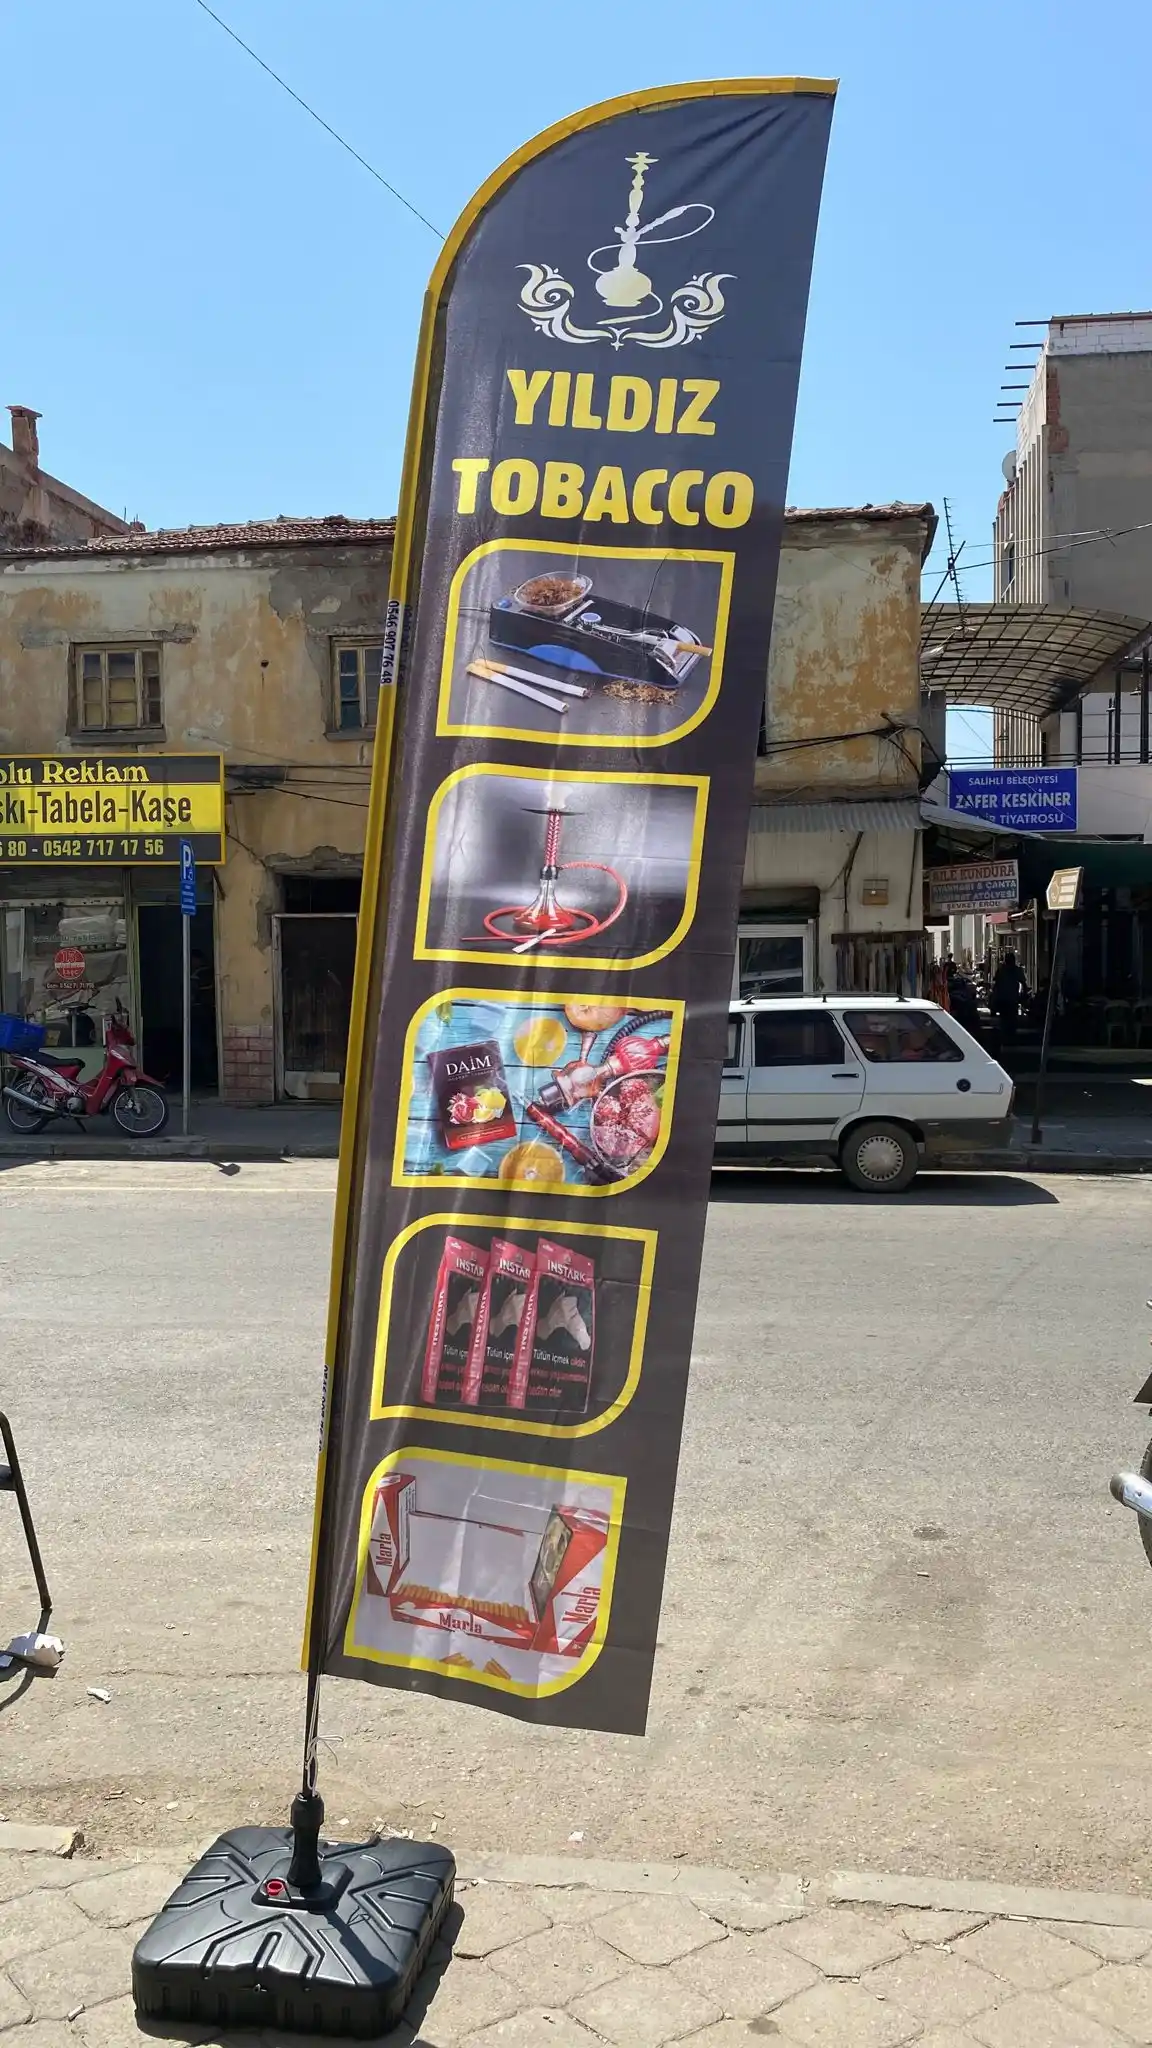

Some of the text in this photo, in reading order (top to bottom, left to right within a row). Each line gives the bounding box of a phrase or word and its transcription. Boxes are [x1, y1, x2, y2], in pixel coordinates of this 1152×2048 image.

[507, 369, 720, 436] YILDIZ
[452, 458, 754, 529] TOBACCO
[380, 600, 400, 684] 0546 907 76 48
[42, 759, 149, 784] Reklam
[0, 789, 192, 828] kı-Tabela-Kaşe
[955, 788, 1071, 809] ZAFER KESKİNER
[999, 811, 1064, 825] TİYATROSU
[8, 840, 27, 857] 80
[43, 840, 81, 857] 0542
[87, 840, 114, 856] 717
[120, 839, 138, 855] 17
[144, 838, 164, 855] 56
[961, 864, 1015, 880] KUNDURA
[547, 1259, 586, 1281] INSTARK
[371, 1532, 393, 1567] Marla
[561, 1586, 601, 1624] Marla
[439, 1611, 483, 1634] Marla
